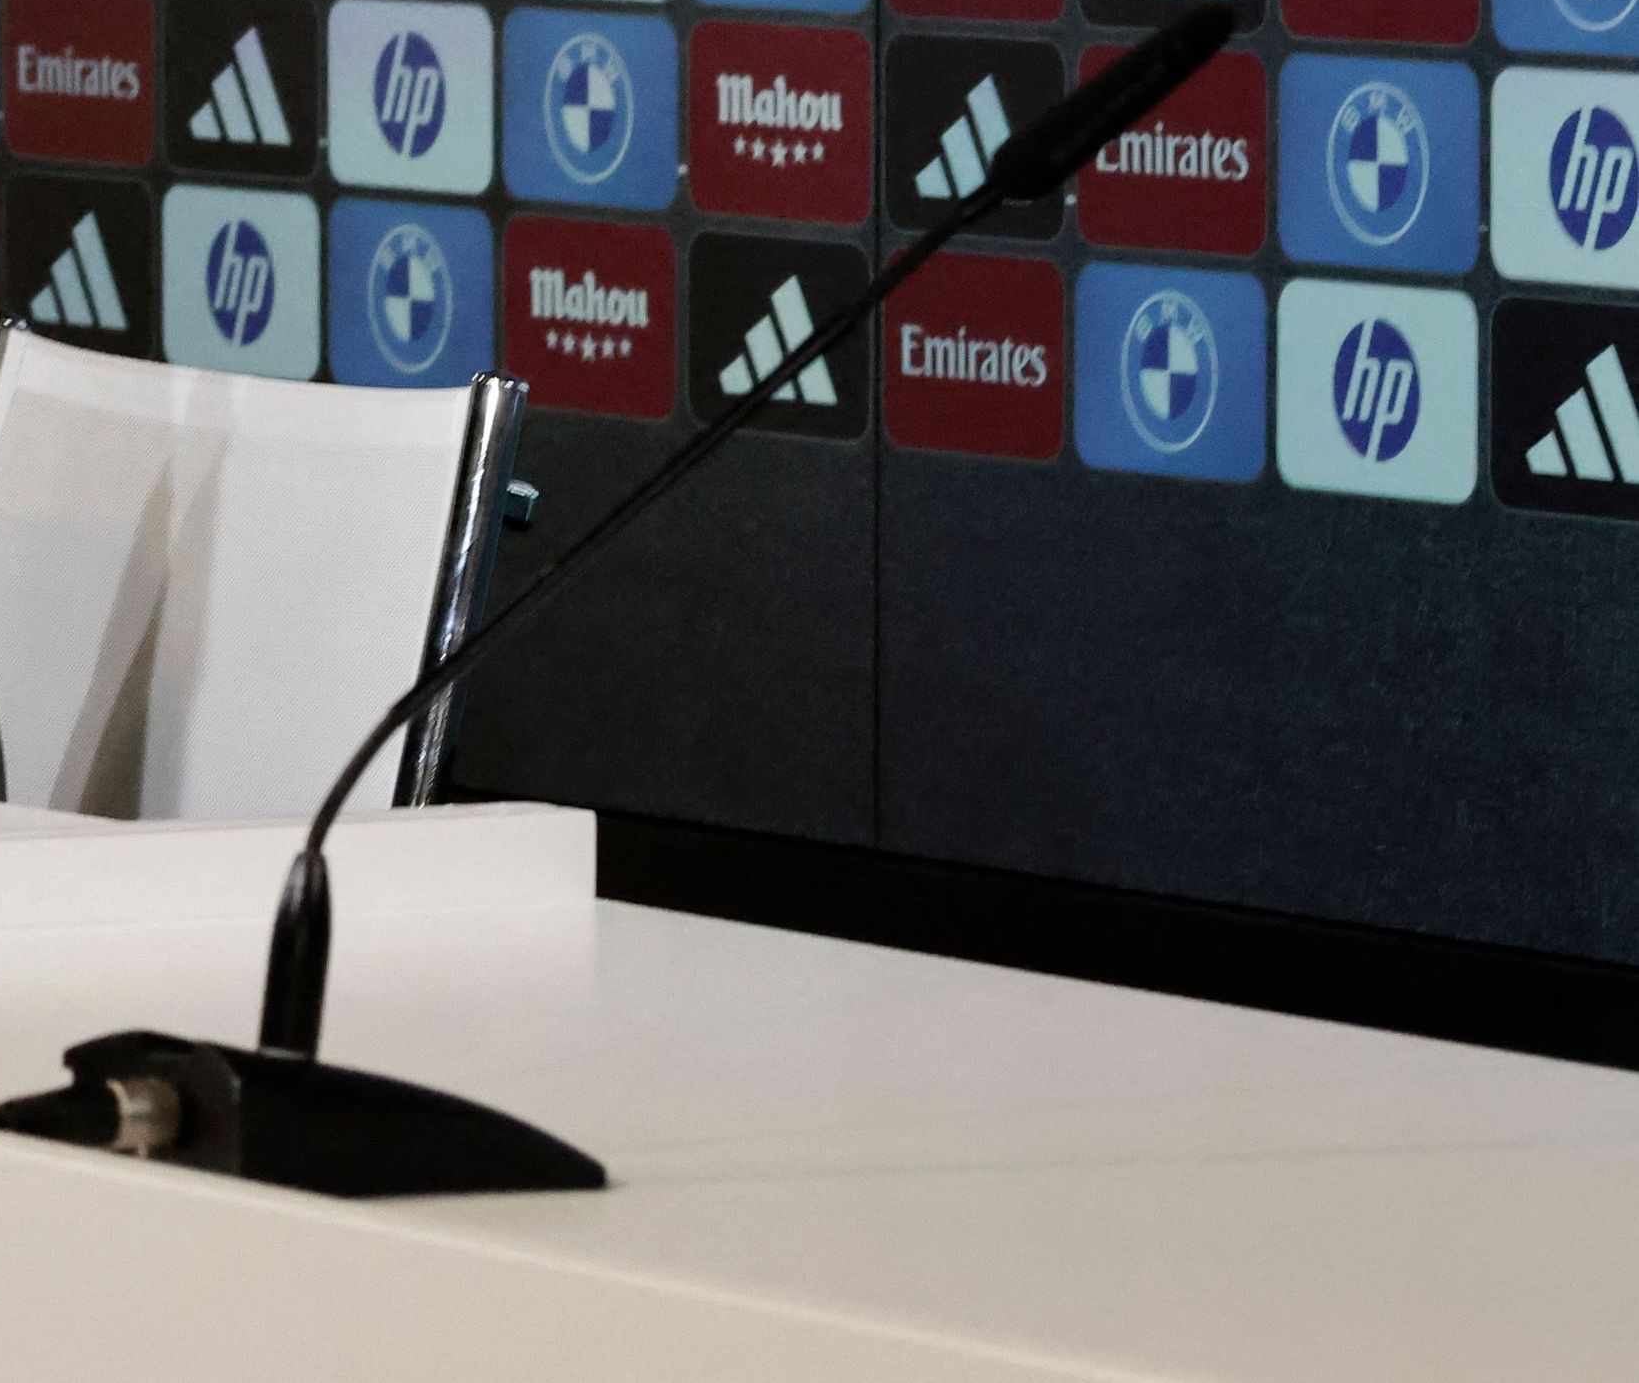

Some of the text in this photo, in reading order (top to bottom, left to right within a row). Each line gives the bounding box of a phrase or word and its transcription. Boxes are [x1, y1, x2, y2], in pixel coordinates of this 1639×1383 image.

[15, 43, 142, 101] Emirates
[380, 33, 440, 158] hp
[715, 72, 844, 133] Mahou
[1557, 107, 1633, 250] hp
[212, 221, 269, 345] hp
[528, 266, 651, 331] Mahou
[899, 322, 1049, 388] Emirates
[1340, 320, 1414, 461] hp
